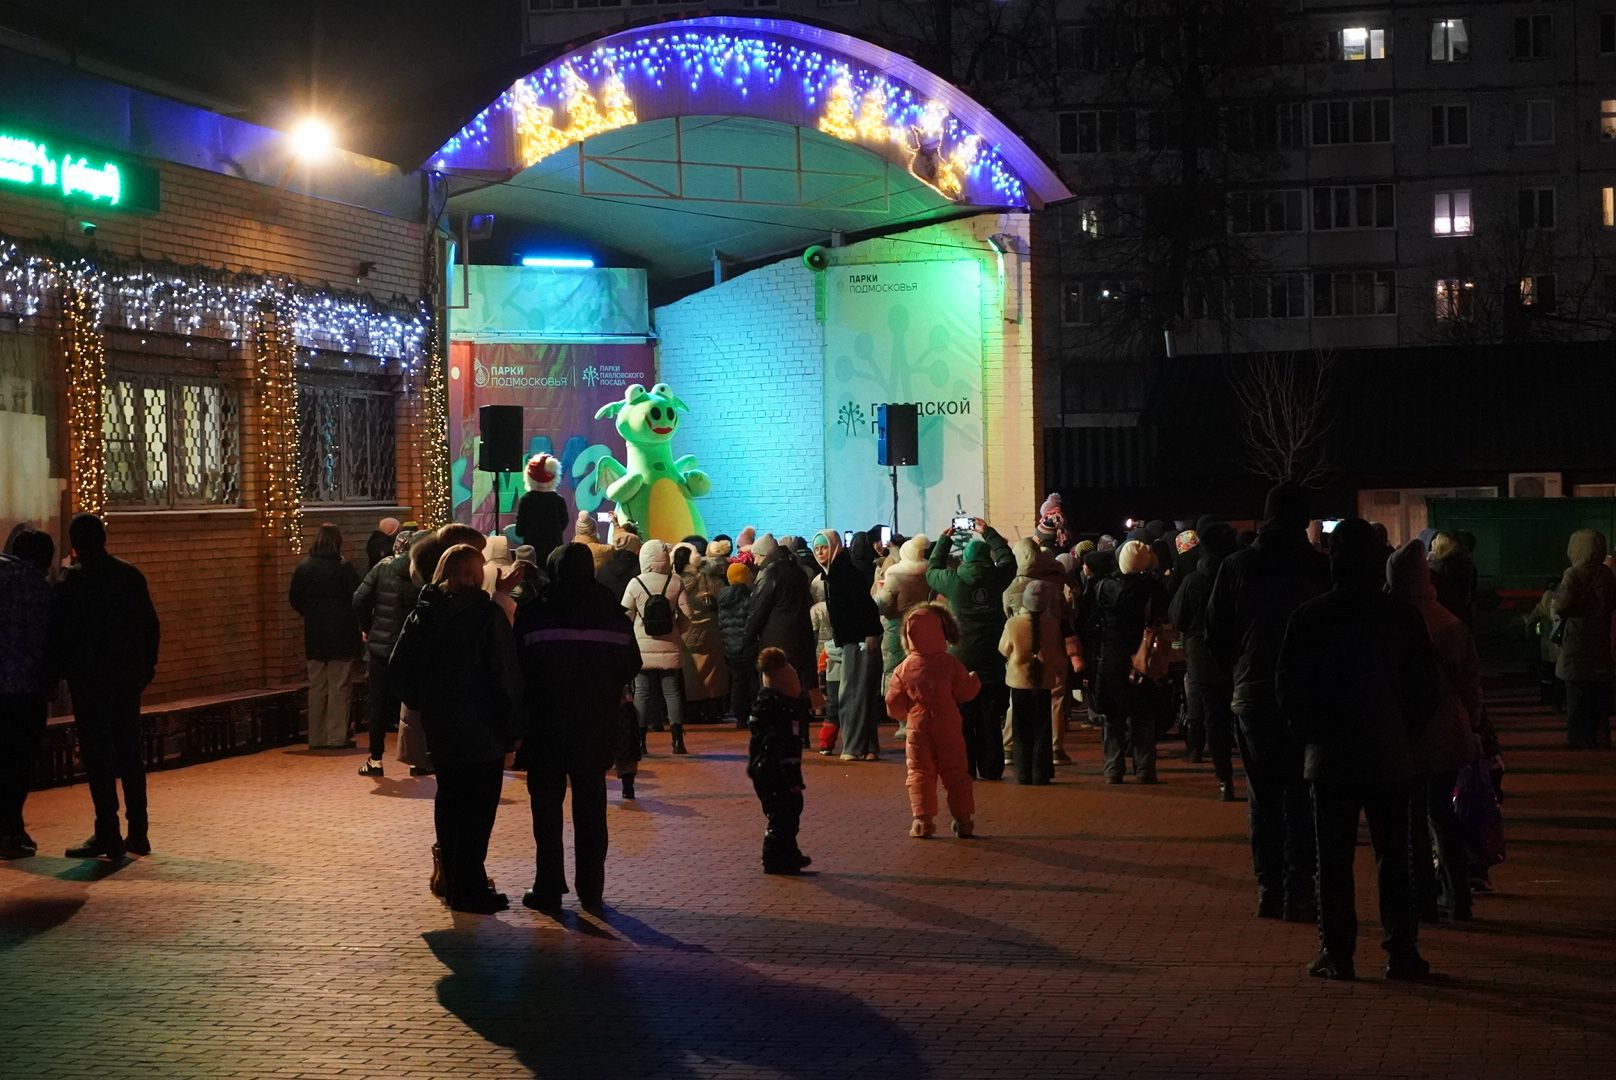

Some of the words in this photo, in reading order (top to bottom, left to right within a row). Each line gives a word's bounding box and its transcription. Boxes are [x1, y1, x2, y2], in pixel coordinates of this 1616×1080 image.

[849, 274, 878, 283] ПАРКИ
[849, 282, 918, 294] ПОДМОСКОВЬЯ
[491, 366, 524, 375] ПАРКИ
[491, 377, 567, 387] ПОДМОСКОВЬЯ
[871, 397, 971, 417] ГДСКОЙ
